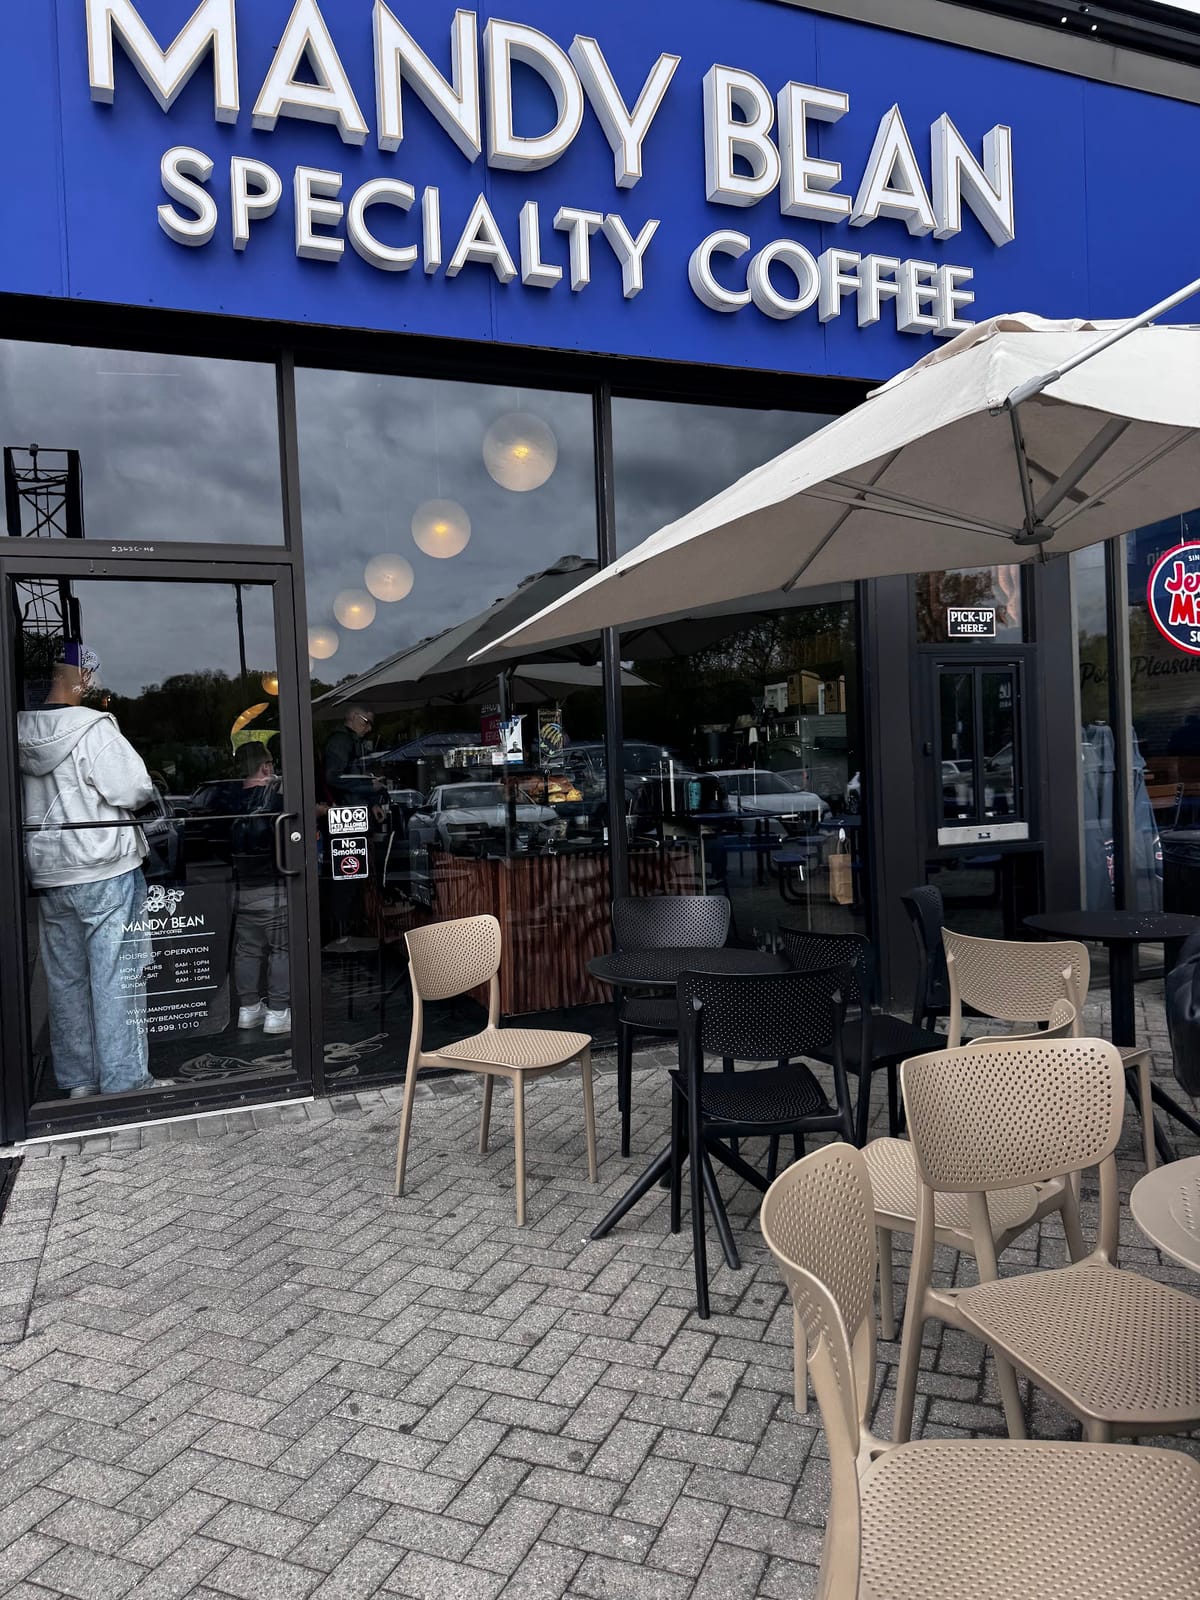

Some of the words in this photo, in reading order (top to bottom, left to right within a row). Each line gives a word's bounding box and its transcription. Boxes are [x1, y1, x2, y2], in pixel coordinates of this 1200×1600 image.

[86, 0, 681, 188] MANDY
[703, 64, 1015, 247] BEAN
[158, 146, 660, 299] SPECIALTY
[688, 230, 975, 337] COFFEE
[950, 611, 993, 623] PICK-UP
[330, 809, 353, 824] NO
[341, 839, 357, 849] No
[332, 847, 366, 857] Smoking
[121, 918, 168, 933] MANDY
[171, 914, 205, 929] BEAN
[119, 952, 149, 961] HOURS
[150, 950, 162, 958] OF
[164, 946, 209, 957] OPERATION
[174, 961, 188, 969] 6AM
[193, 959, 210, 967] 10PM
[147, 972, 159, 980] SAT
[175, 968, 189, 977] 6AM
[193, 967, 210, 975] 12AM
[121, 981, 147, 990] SUNDAY
[175, 976, 189, 984] 6AM
[194, 974, 210, 982] 10PM
[126, 1001, 206, 1015] WWW.MANDYBEAN.COM
[126, 1010, 209, 1026] @MANDYBEANCOFFEE
[138, 1020, 200, 1035] 914.999.1010
